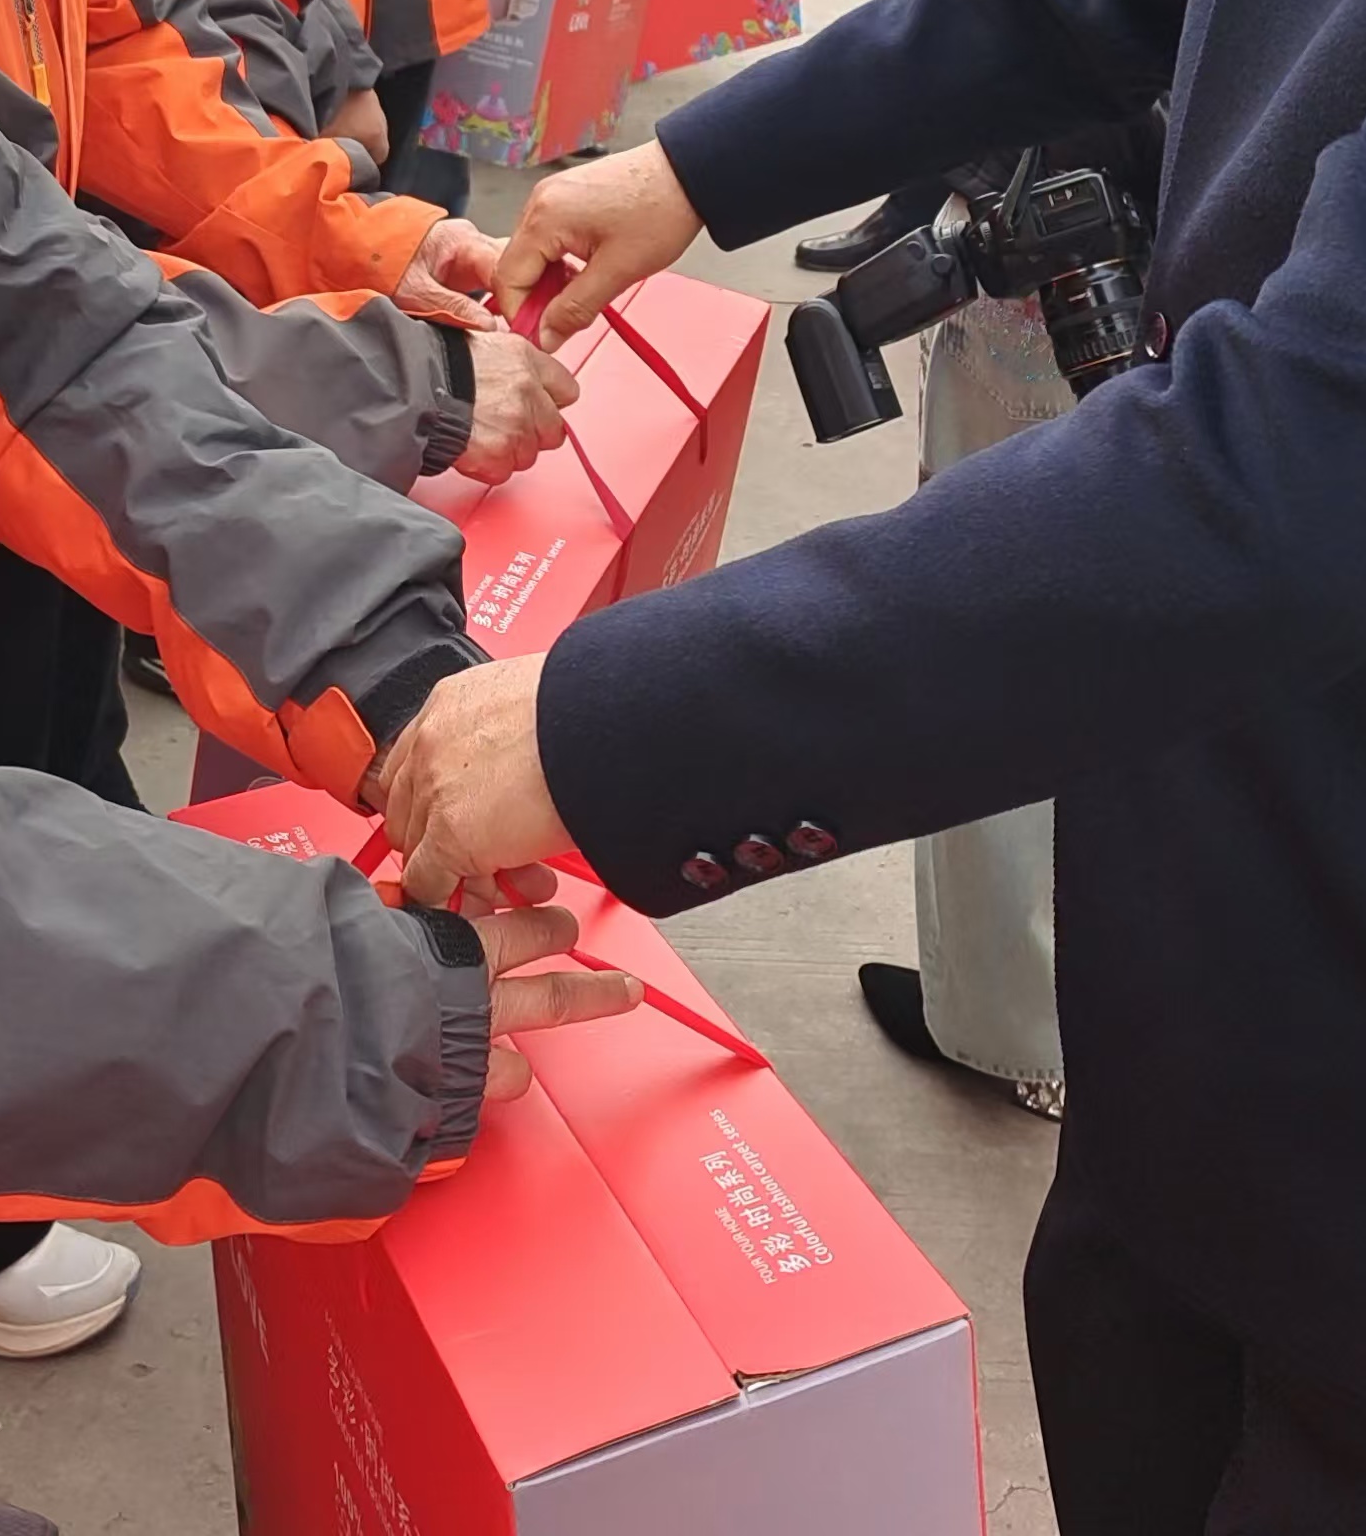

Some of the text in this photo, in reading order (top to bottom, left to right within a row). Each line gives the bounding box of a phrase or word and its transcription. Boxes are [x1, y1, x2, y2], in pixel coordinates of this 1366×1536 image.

[493, 601, 522, 634] Colorful
[512, 578, 539, 604] fashion
[699, 1150, 812, 1273] 多彩·时尚系列
[709, 1108, 834, 1265] Colorful fashion carpet series
[715, 1206, 740, 1235] HOME
[732, 1231, 757, 1260] YOUR
